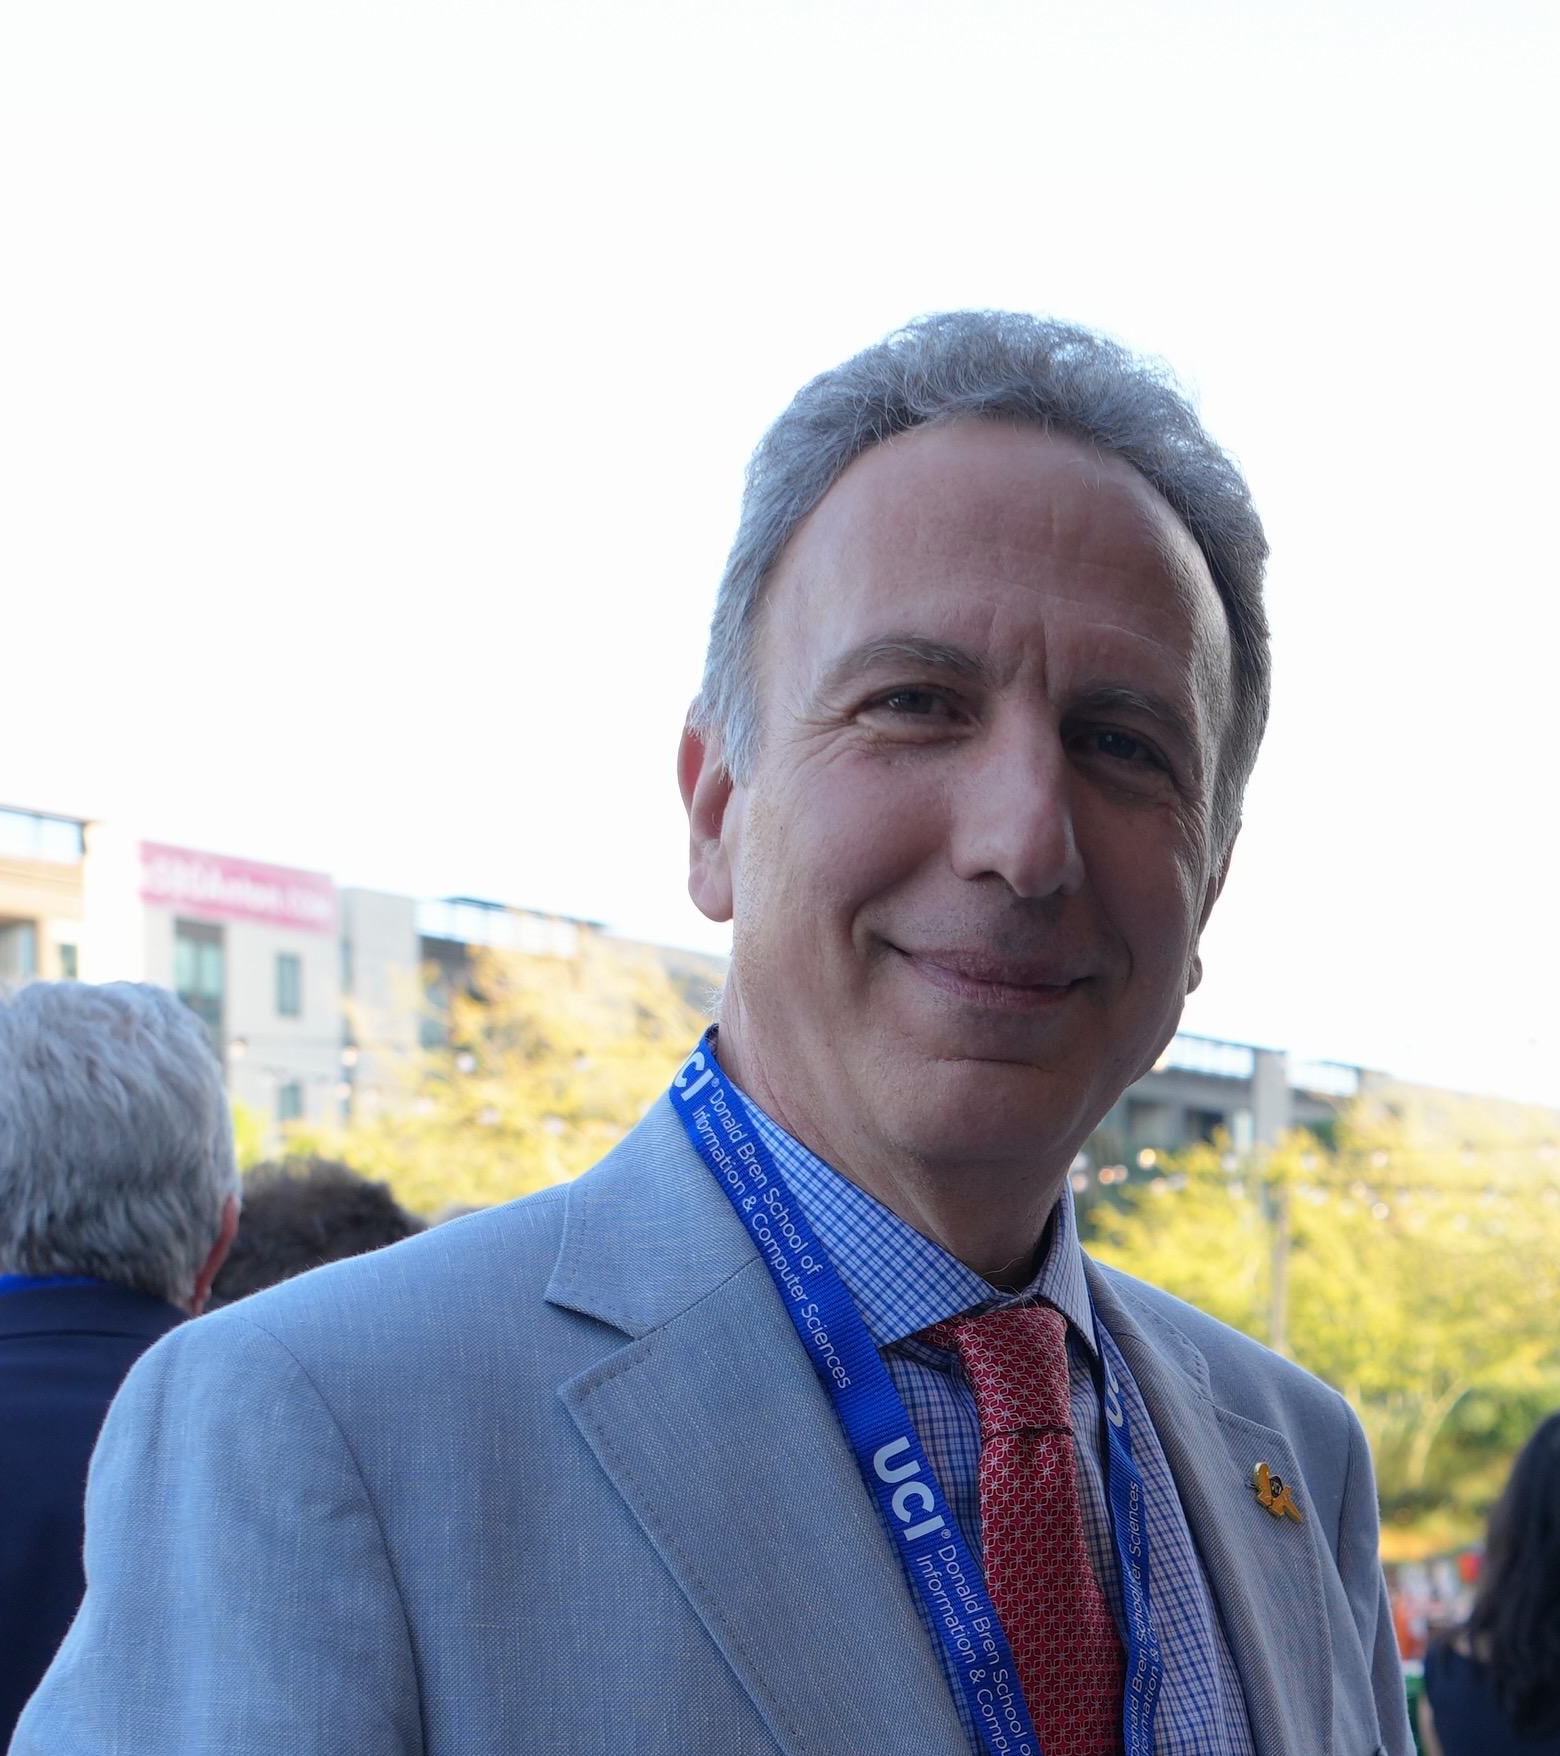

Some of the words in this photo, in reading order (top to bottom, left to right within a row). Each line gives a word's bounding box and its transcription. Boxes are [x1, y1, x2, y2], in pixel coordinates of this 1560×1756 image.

[674, 1048, 714, 1101] CI
[709, 1089, 748, 1144] Donald
[737, 1142, 768, 1190] Bren
[764, 1188, 808, 1254] School
[801, 1256, 823, 1275] of
[692, 1105, 746, 1195] Information
[742, 1196, 756, 1213] &
[752, 1213, 808, 1302] Computer
[801, 1303, 852, 1389] Sciences
[873, 1436, 946, 1541] UCI
[1129, 1482, 1140, 1557] Sciences
[916, 1554, 977, 1664] Information
[969, 1669, 986, 1684] &
[938, 1545, 984, 1614] Donald
[973, 1616, 1001, 1665] Bren
[993, 1669, 1028, 1739] School
[1132, 1649, 1147, 1693] Bren
